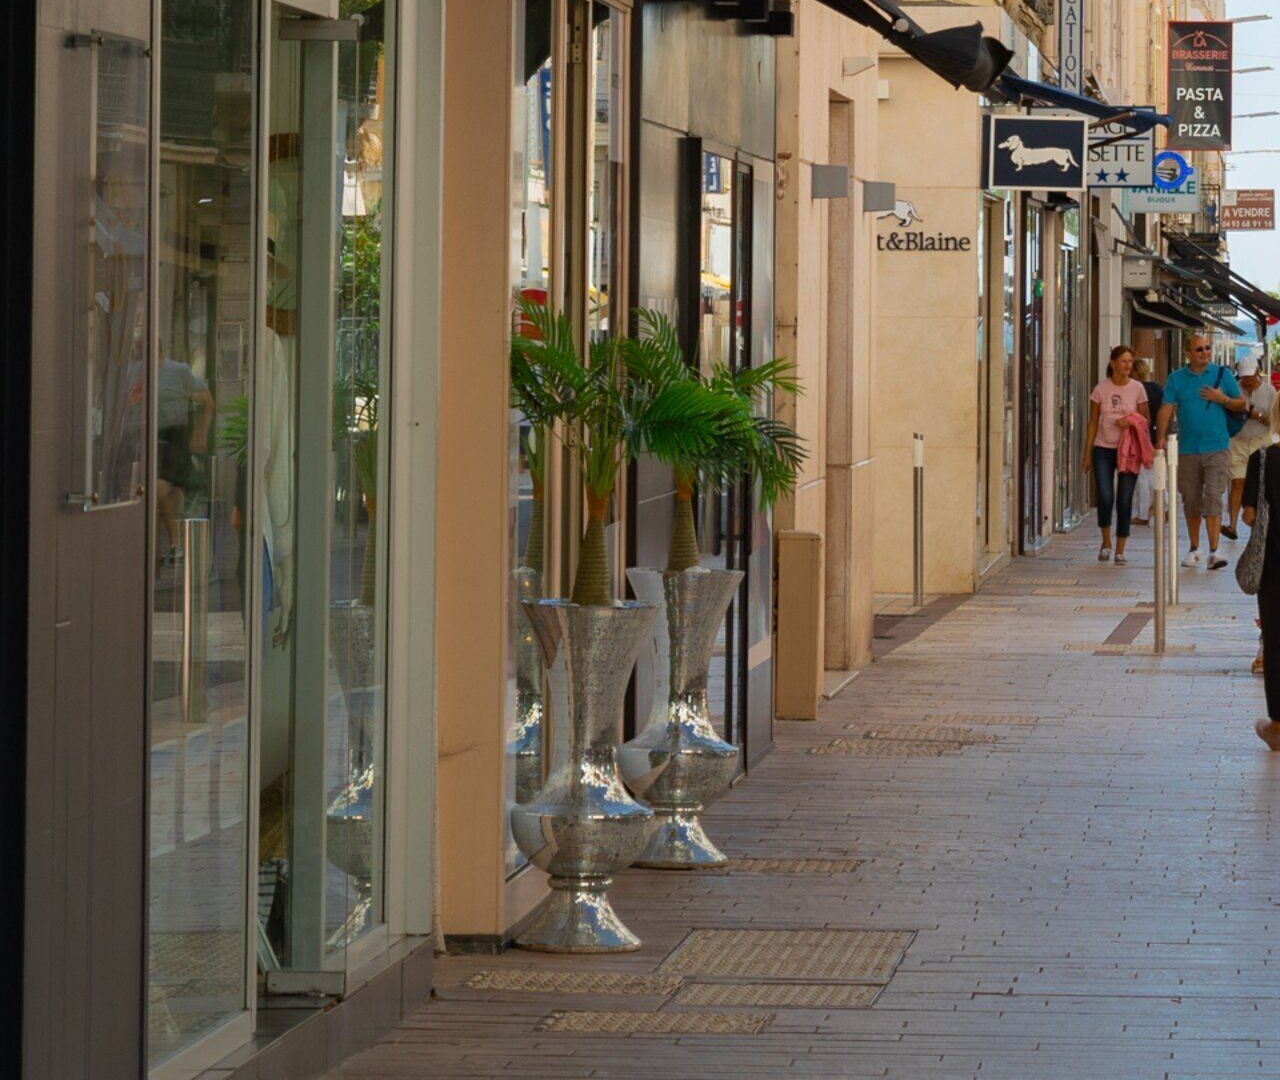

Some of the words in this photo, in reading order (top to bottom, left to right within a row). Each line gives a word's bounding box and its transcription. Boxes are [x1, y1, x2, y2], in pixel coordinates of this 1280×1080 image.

[1172, 50, 1228, 60] BRASSERIE
[1176, 88, 1224, 101] PASTA
[1193, 106, 1205, 119] &
[1178, 124, 1221, 137] PIZZA
[1232, 207, 1271, 218] VENDRE
[877, 231, 971, 251] t&Blaine
